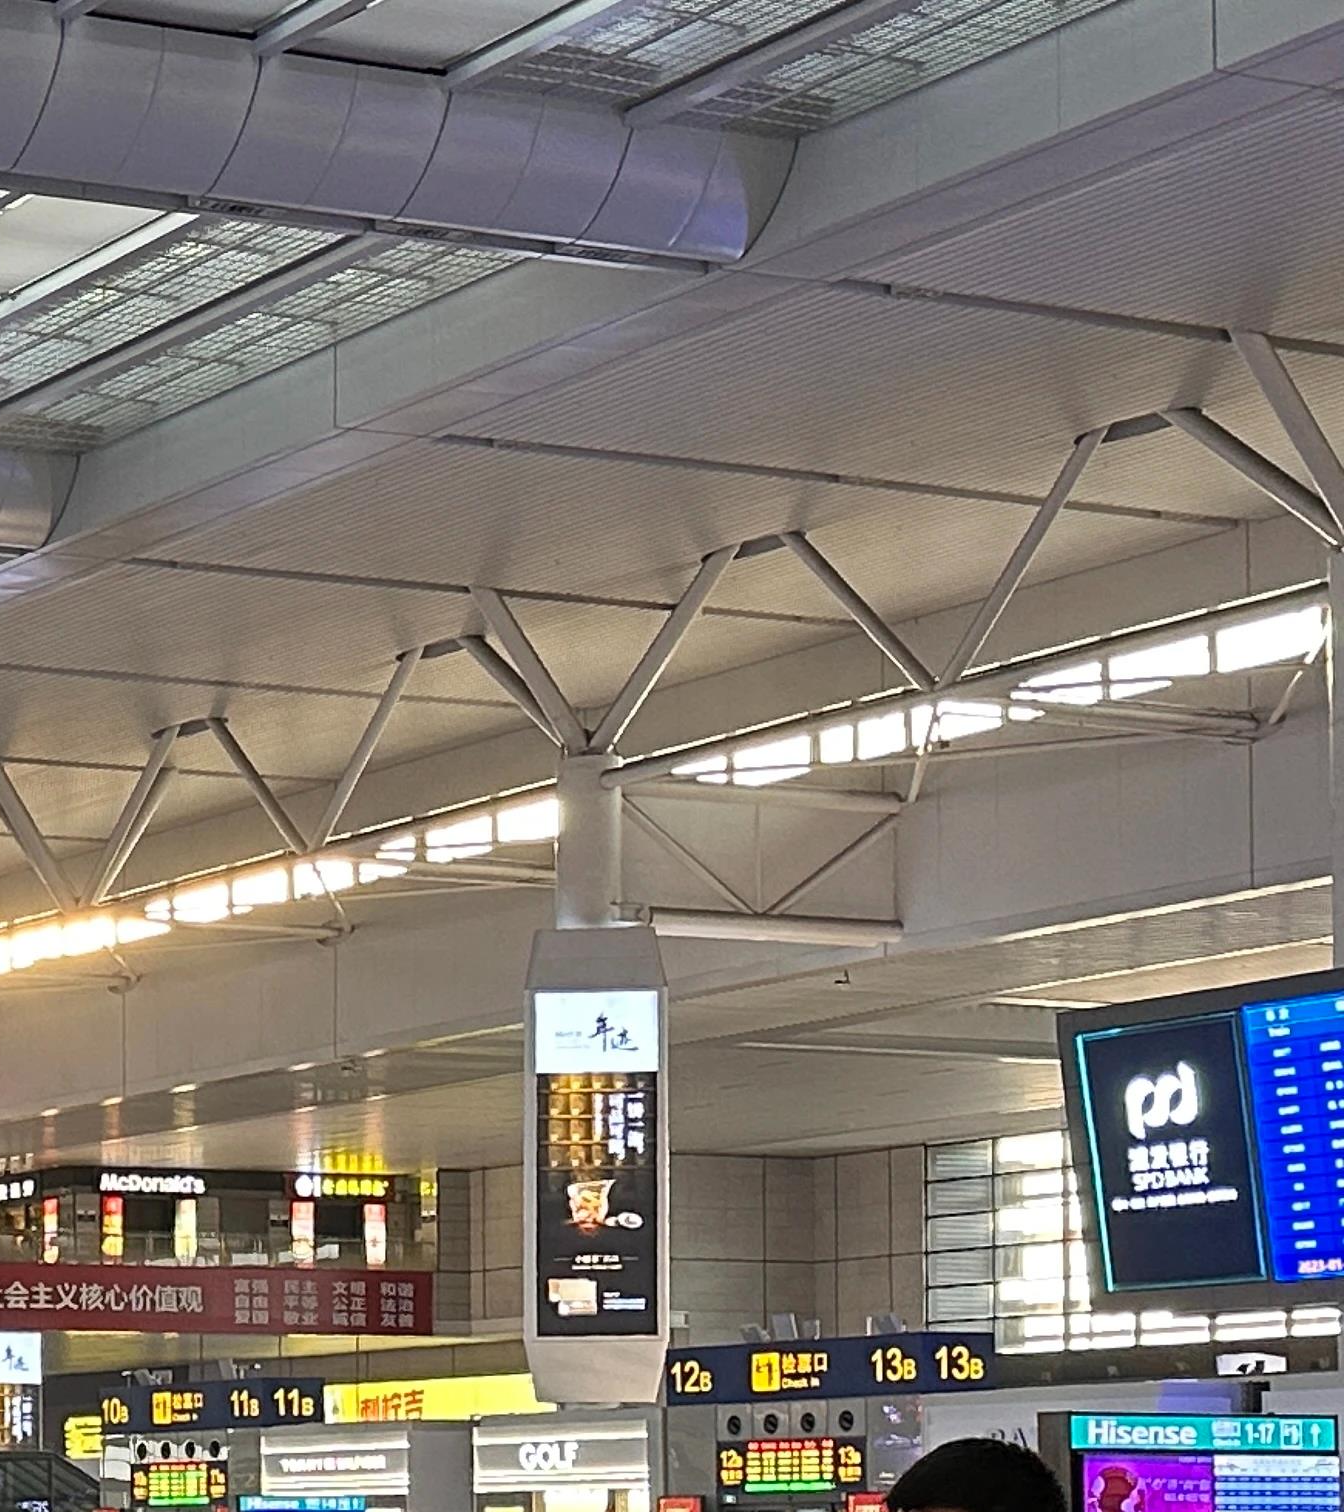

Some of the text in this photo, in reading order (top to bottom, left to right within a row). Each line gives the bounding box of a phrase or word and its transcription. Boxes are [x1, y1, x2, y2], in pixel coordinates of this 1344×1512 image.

[100, 1173, 205, 1195] McDonald's
[234, 1279, 414, 1297] 富强 民主 文明 和谐
[234, 1295, 414, 1313] 自由 平等 公正 法治
[234, 1310, 414, 1328] 爱国 敬业 诚信 友善
[670, 1360, 712, 1393] 12B
[871, 1347, 917, 1383] 13B
[934, 1345, 984, 1380] 13B
[102, 1398, 129, 1424] 10B
[230, 1389, 260, 1418] 11B
[273, 1388, 315, 1417] 11B
[1087, 1419, 1198, 1446] Hisense
[1245, 1422, 1276, 1445] 1-17
[518, 1442, 580, 1471] GOLF
